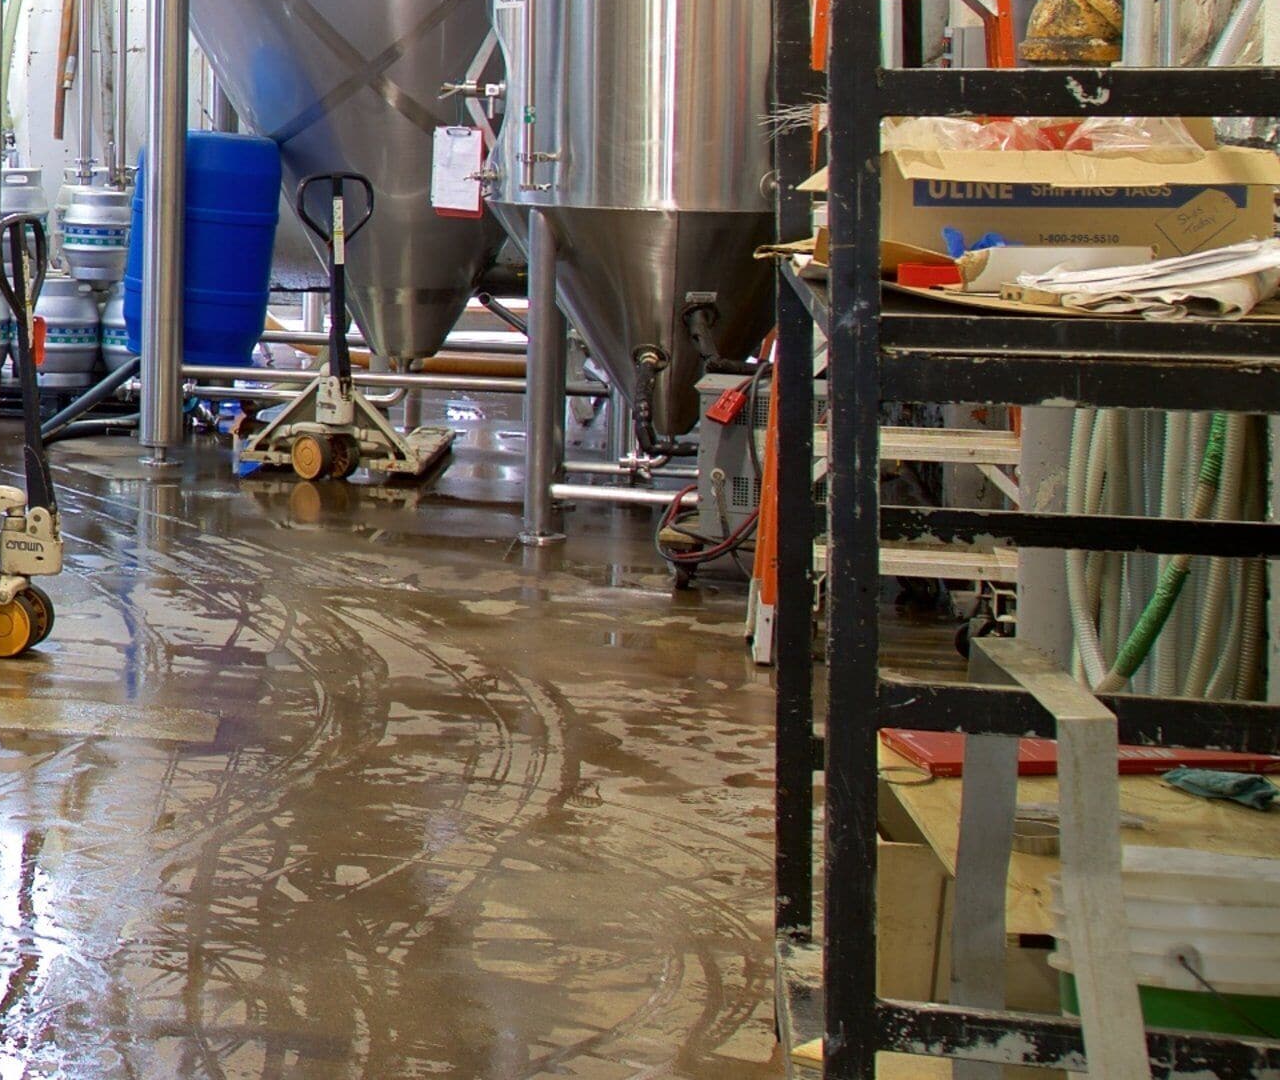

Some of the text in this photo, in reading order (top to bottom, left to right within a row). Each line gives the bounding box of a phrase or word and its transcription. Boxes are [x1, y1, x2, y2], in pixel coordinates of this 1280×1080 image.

[928, 180, 1013, 200] ULINE
[1039, 233, 1119, 244] 1-800-295-5510
[5, 540, 44, 553] CROWN
